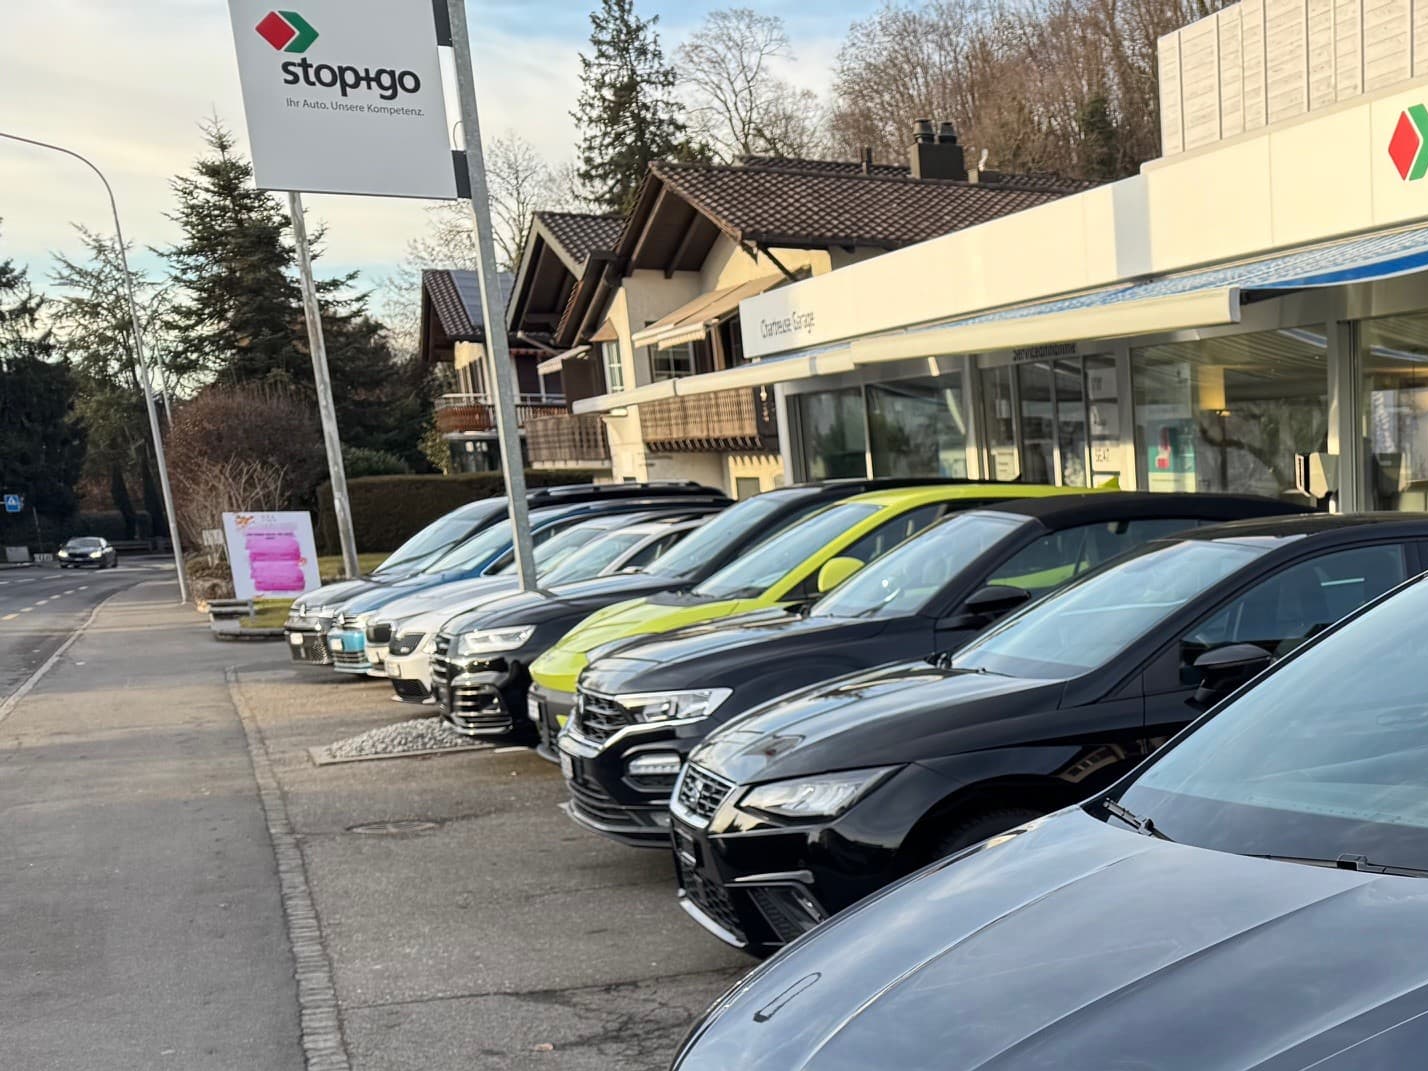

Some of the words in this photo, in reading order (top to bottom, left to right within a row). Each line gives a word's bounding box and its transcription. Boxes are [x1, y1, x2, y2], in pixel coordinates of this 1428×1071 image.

[281, 57, 421, 101] stop+go
[286, 98, 300, 108] Ihr
[302, 99, 329, 110] Auto.
[331, 102, 365, 112] Unsere
[366, 103, 425, 117] Kompetenz.
[792, 311, 815, 334] Garage
